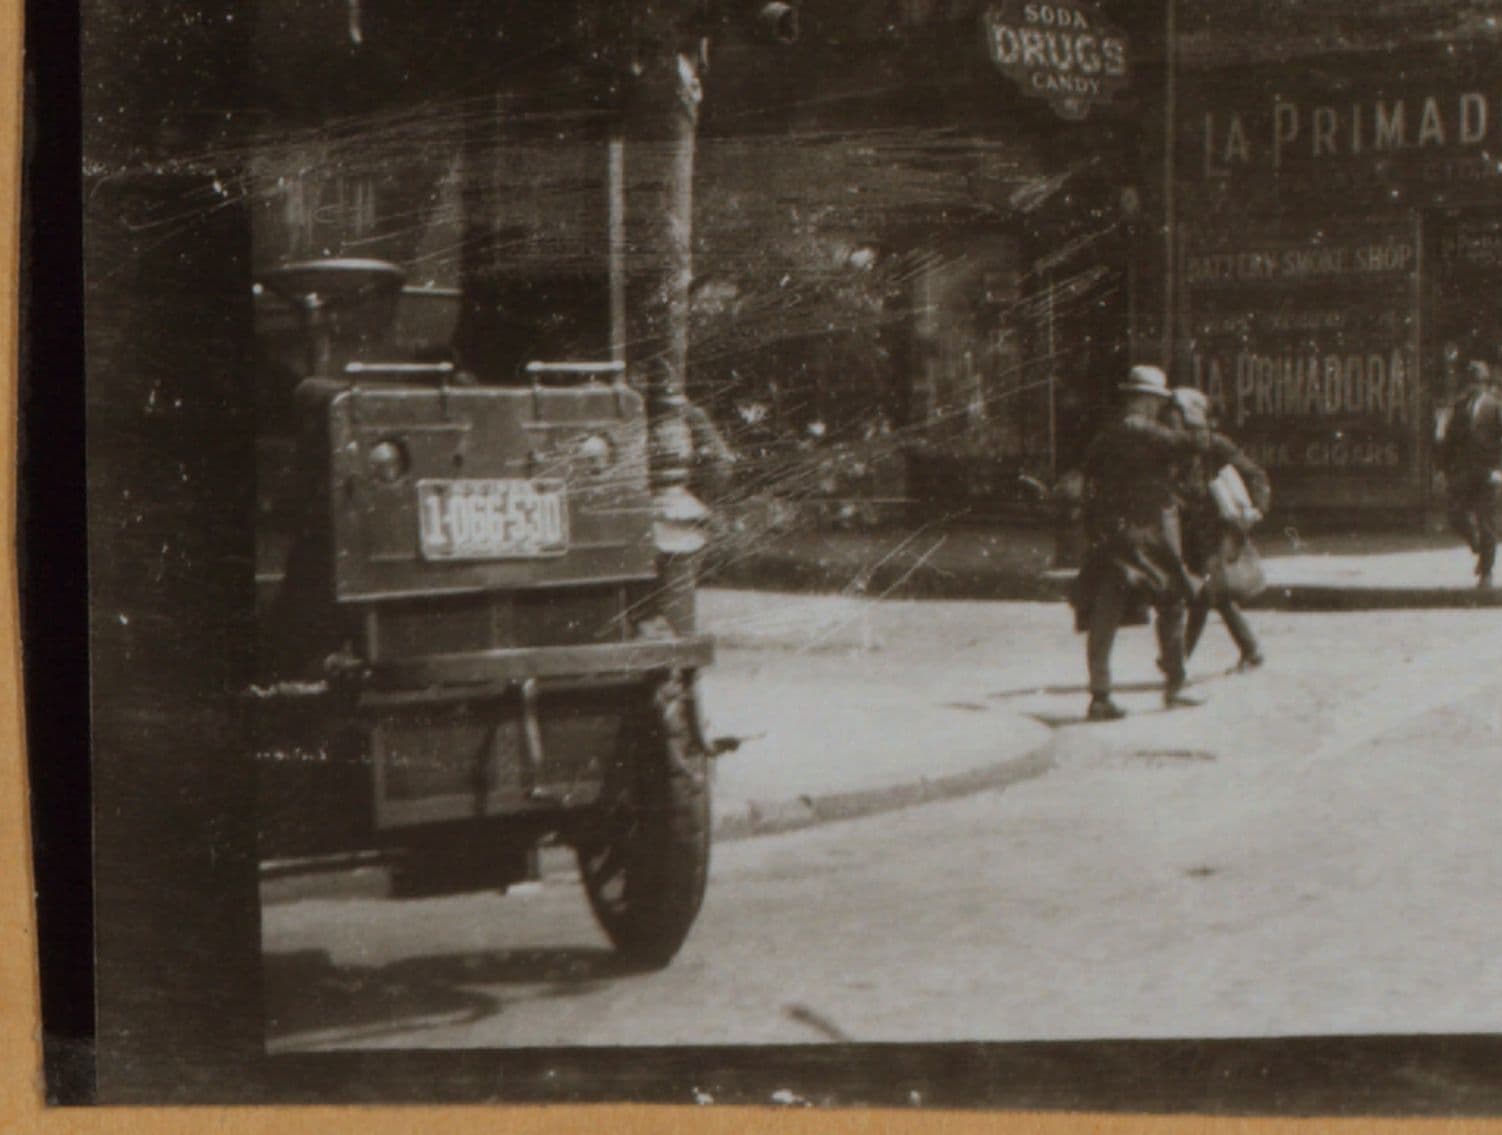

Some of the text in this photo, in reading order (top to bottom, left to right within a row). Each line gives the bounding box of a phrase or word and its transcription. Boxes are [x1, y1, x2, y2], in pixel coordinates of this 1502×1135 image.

[1024, 4, 1088, 29] SODA
[992, 23, 1126, 77] DRUGS
[1032, 70, 1099, 95] CANDY
[1204, 111, 1250, 177] LA
[1355, 243, 1413, 272] SHOP
[1236, 348, 1408, 428] PRIMADORA
